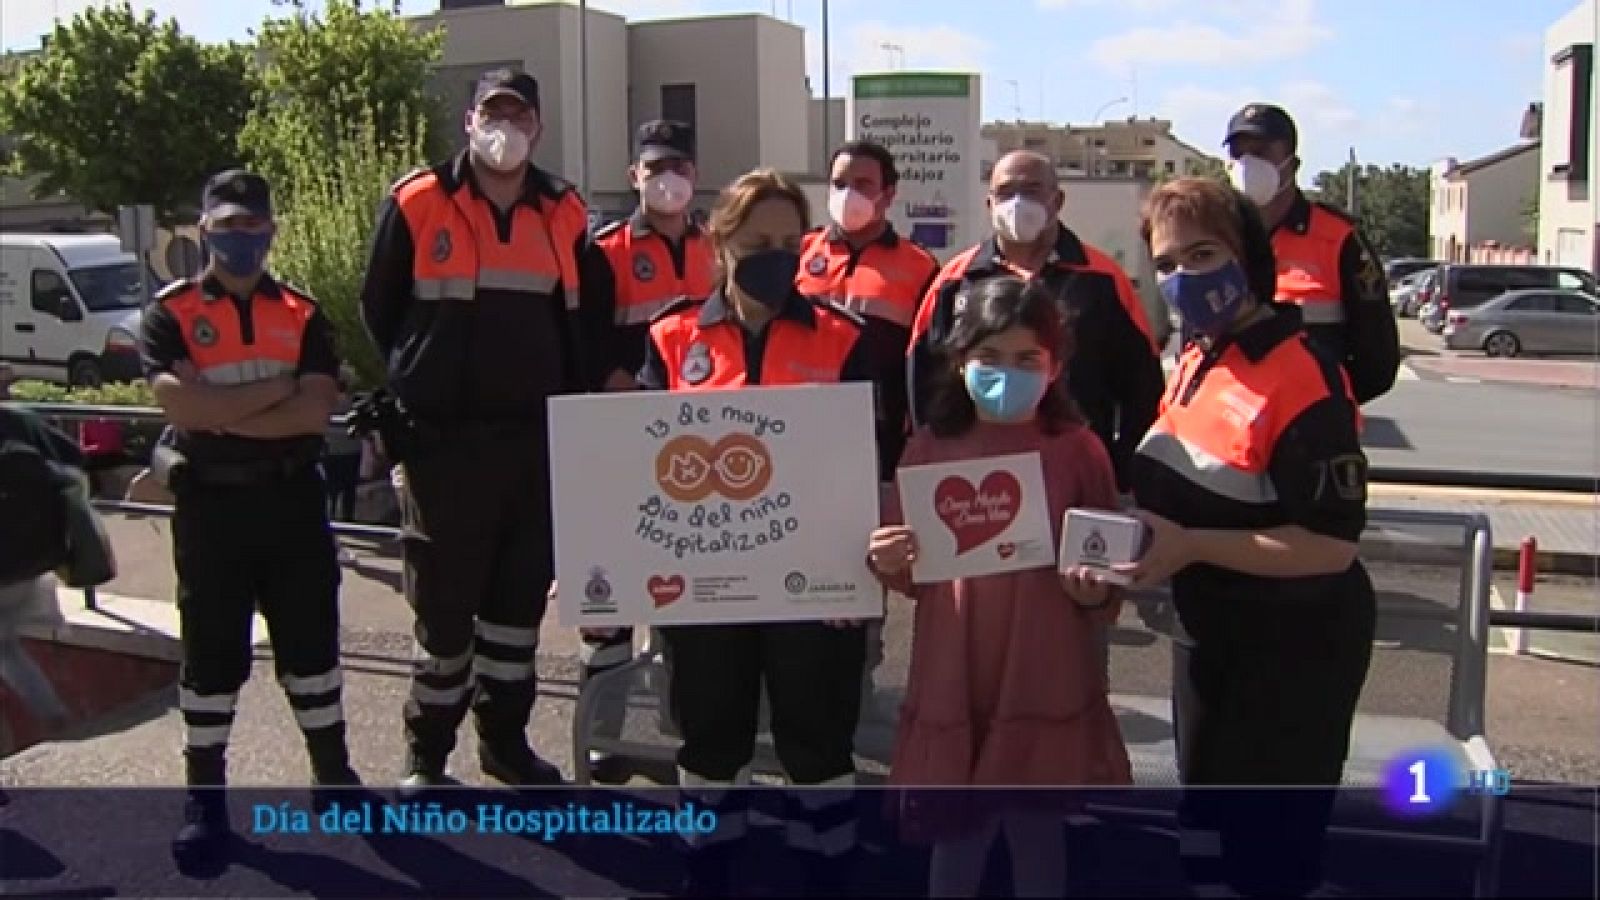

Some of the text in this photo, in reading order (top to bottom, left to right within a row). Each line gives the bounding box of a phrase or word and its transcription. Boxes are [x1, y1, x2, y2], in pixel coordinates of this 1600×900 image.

[860, 114, 931, 131] Complejo
[896, 167, 944, 184] adajoz
[644, 401, 786, 438] 13 de mayo
[688, 502, 732, 528] del
[739, 492, 791, 523] niño
[635, 517, 799, 559] Hospitalizado
